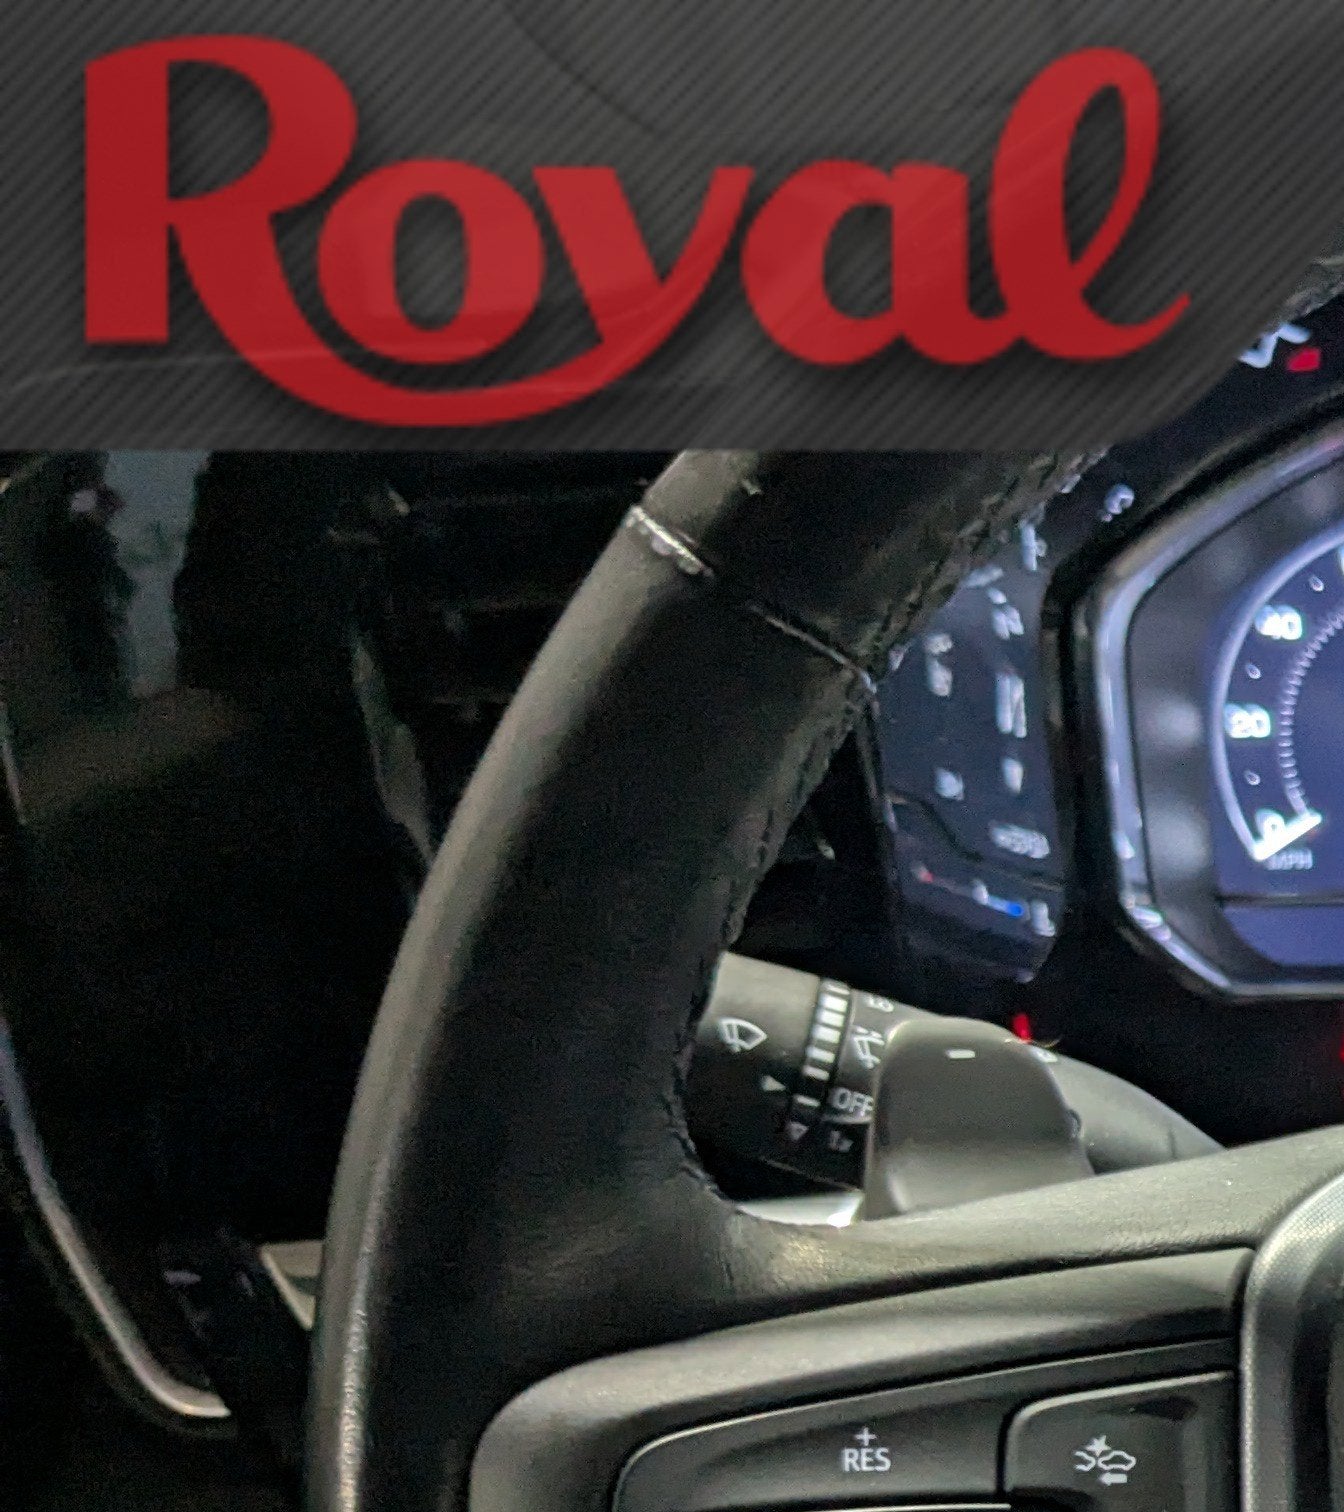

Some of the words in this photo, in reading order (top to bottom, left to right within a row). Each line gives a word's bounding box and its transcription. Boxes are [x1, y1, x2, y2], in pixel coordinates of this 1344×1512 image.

[1255, 603, 1303, 640] 40
[1225, 704, 1270, 739] 20
[830, 1087, 874, 1117] OFF
[843, 1448, 891, 1473] RES
